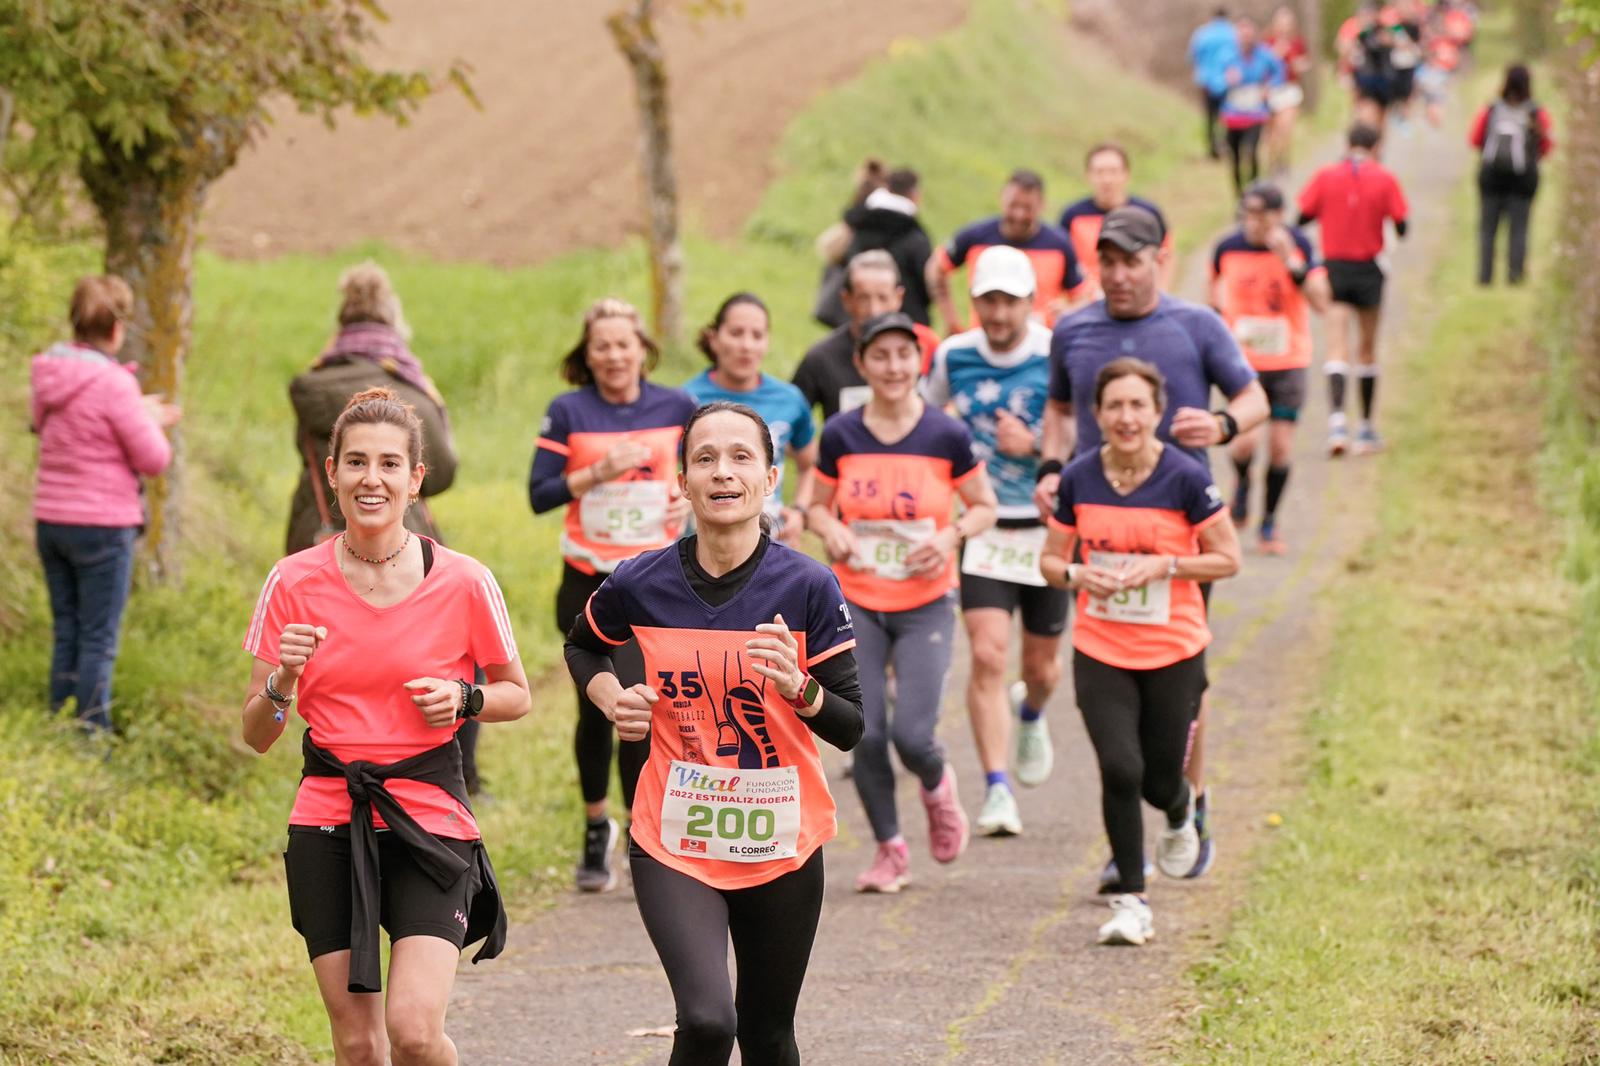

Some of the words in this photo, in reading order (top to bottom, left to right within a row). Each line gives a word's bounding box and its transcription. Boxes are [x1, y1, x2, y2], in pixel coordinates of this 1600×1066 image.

[607, 507, 643, 531] 52
[657, 671, 703, 699] 35
[675, 766, 740, 792] Vital
[669, 789, 694, 800] 2022
[695, 793, 754, 805] ESTIBALIZ
[756, 795, 796, 805] IGOERA
[686, 804, 776, 842] 200
[729, 845, 740, 855] EL
[741, 844, 776, 855] CORREO
